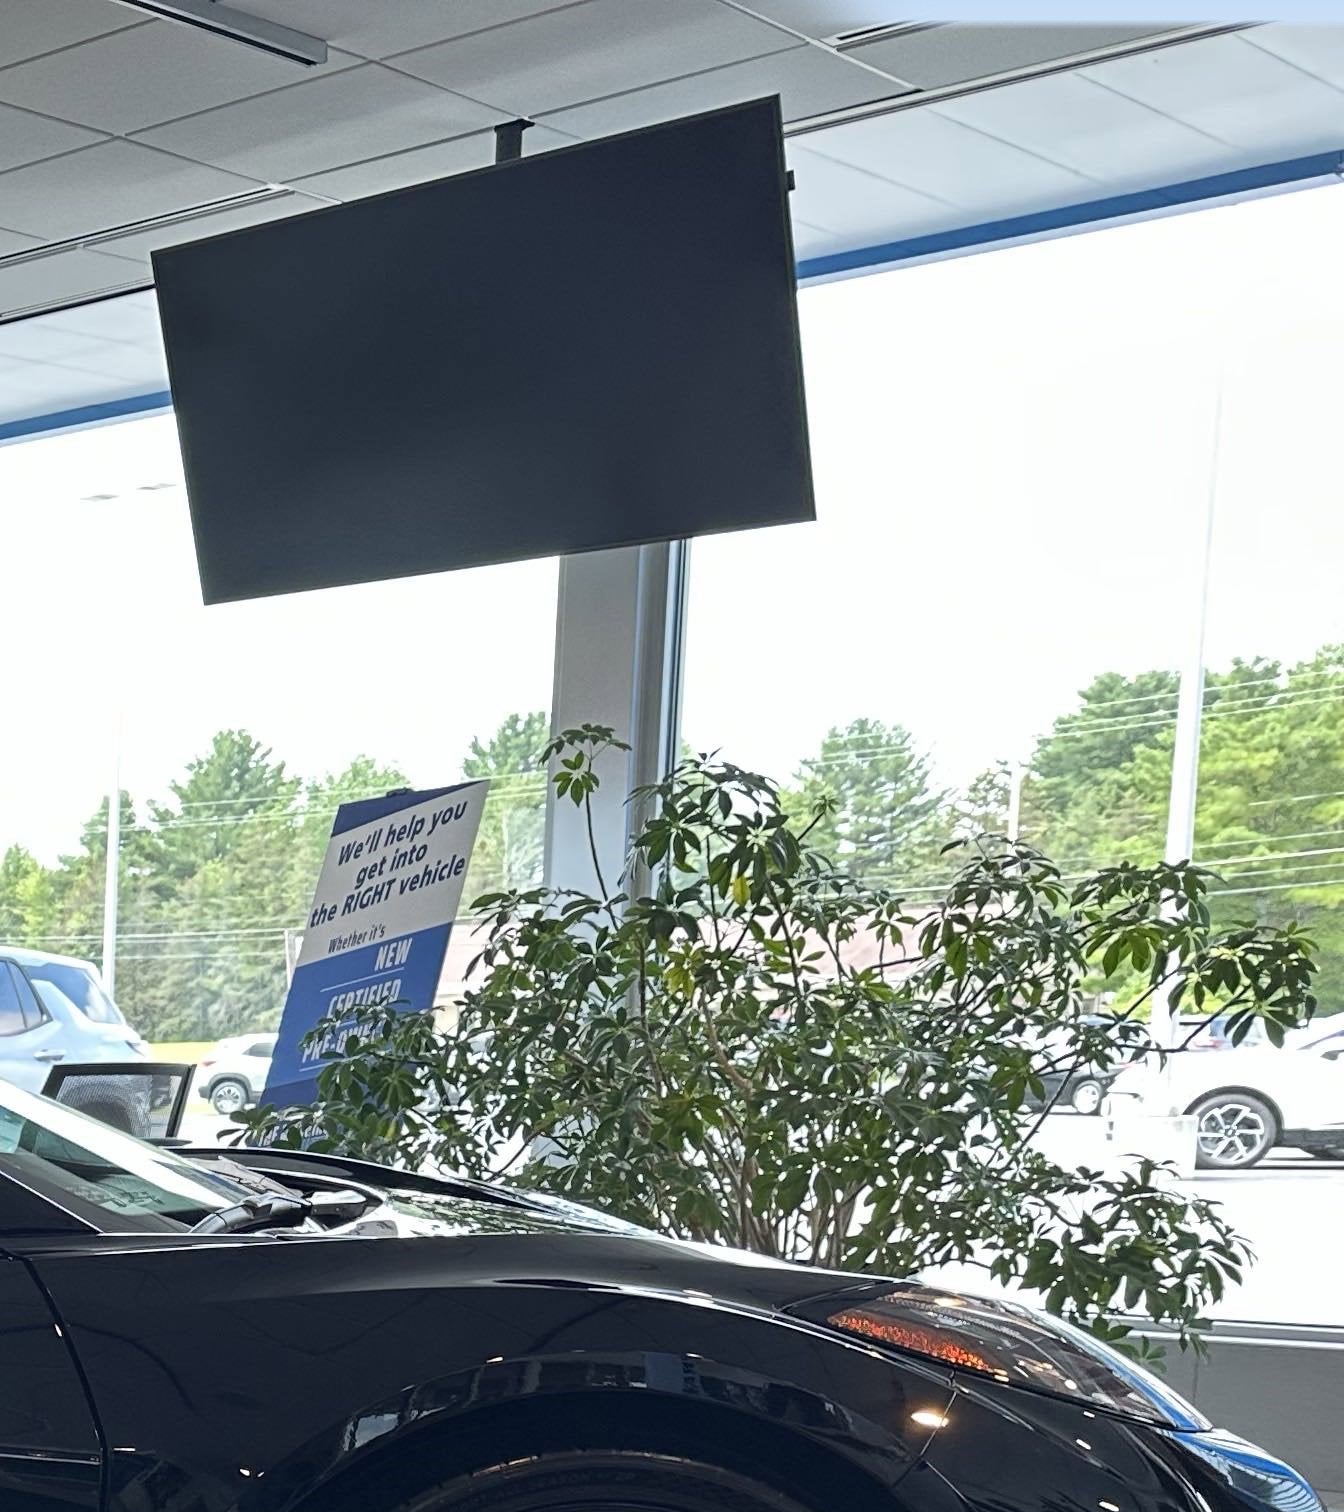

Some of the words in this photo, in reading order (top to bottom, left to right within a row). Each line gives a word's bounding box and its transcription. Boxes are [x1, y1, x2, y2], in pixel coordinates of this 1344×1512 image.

[338, 830, 381, 867] We'll
[385, 815, 425, 849] help
[428, 801, 468, 835] you
[354, 860, 385, 890] get
[389, 843, 427, 875] into
[310, 901, 335, 928] the
[342, 881, 394, 917] RIGHT
[399, 857, 465, 893] vehicle
[328, 929, 368, 954] Whether
[369, 924, 387, 942] it's
[374, 937, 413, 971] NEW
